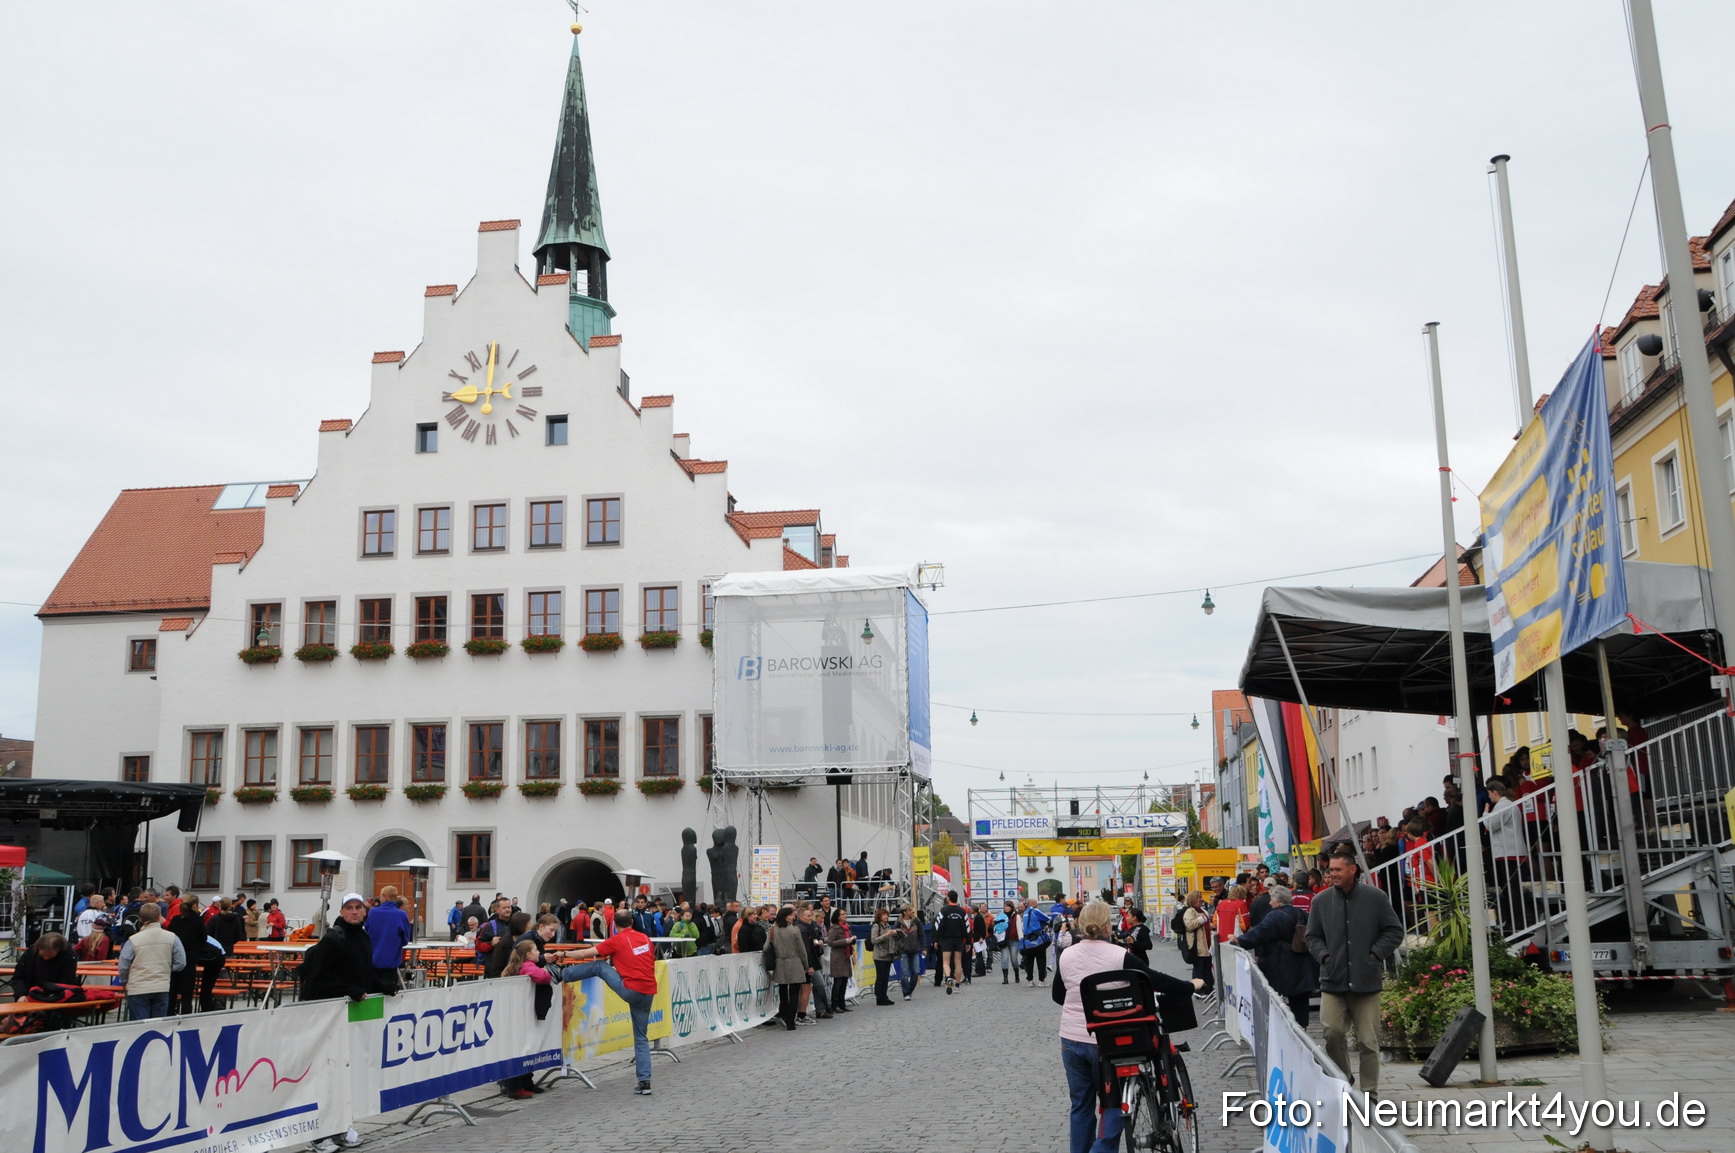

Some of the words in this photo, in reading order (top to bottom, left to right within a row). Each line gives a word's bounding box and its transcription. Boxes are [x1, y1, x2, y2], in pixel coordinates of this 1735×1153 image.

[767, 656, 853, 672] BAROWSKI
[858, 654, 883, 669] AG
[768, 743, 860, 753] www.barowski-ag.de
[992, 817, 1049, 829] PFLEIDERER
[1106, 815, 1171, 829] BOCK
[1065, 842, 1094, 853] ZIEL
[1593, 950, 1609, 959] 777
[381, 1000, 494, 1069] BOCK
[32, 1024, 244, 1153] MCM
[247, 1118, 319, 1146] KASSENSYSTEME
